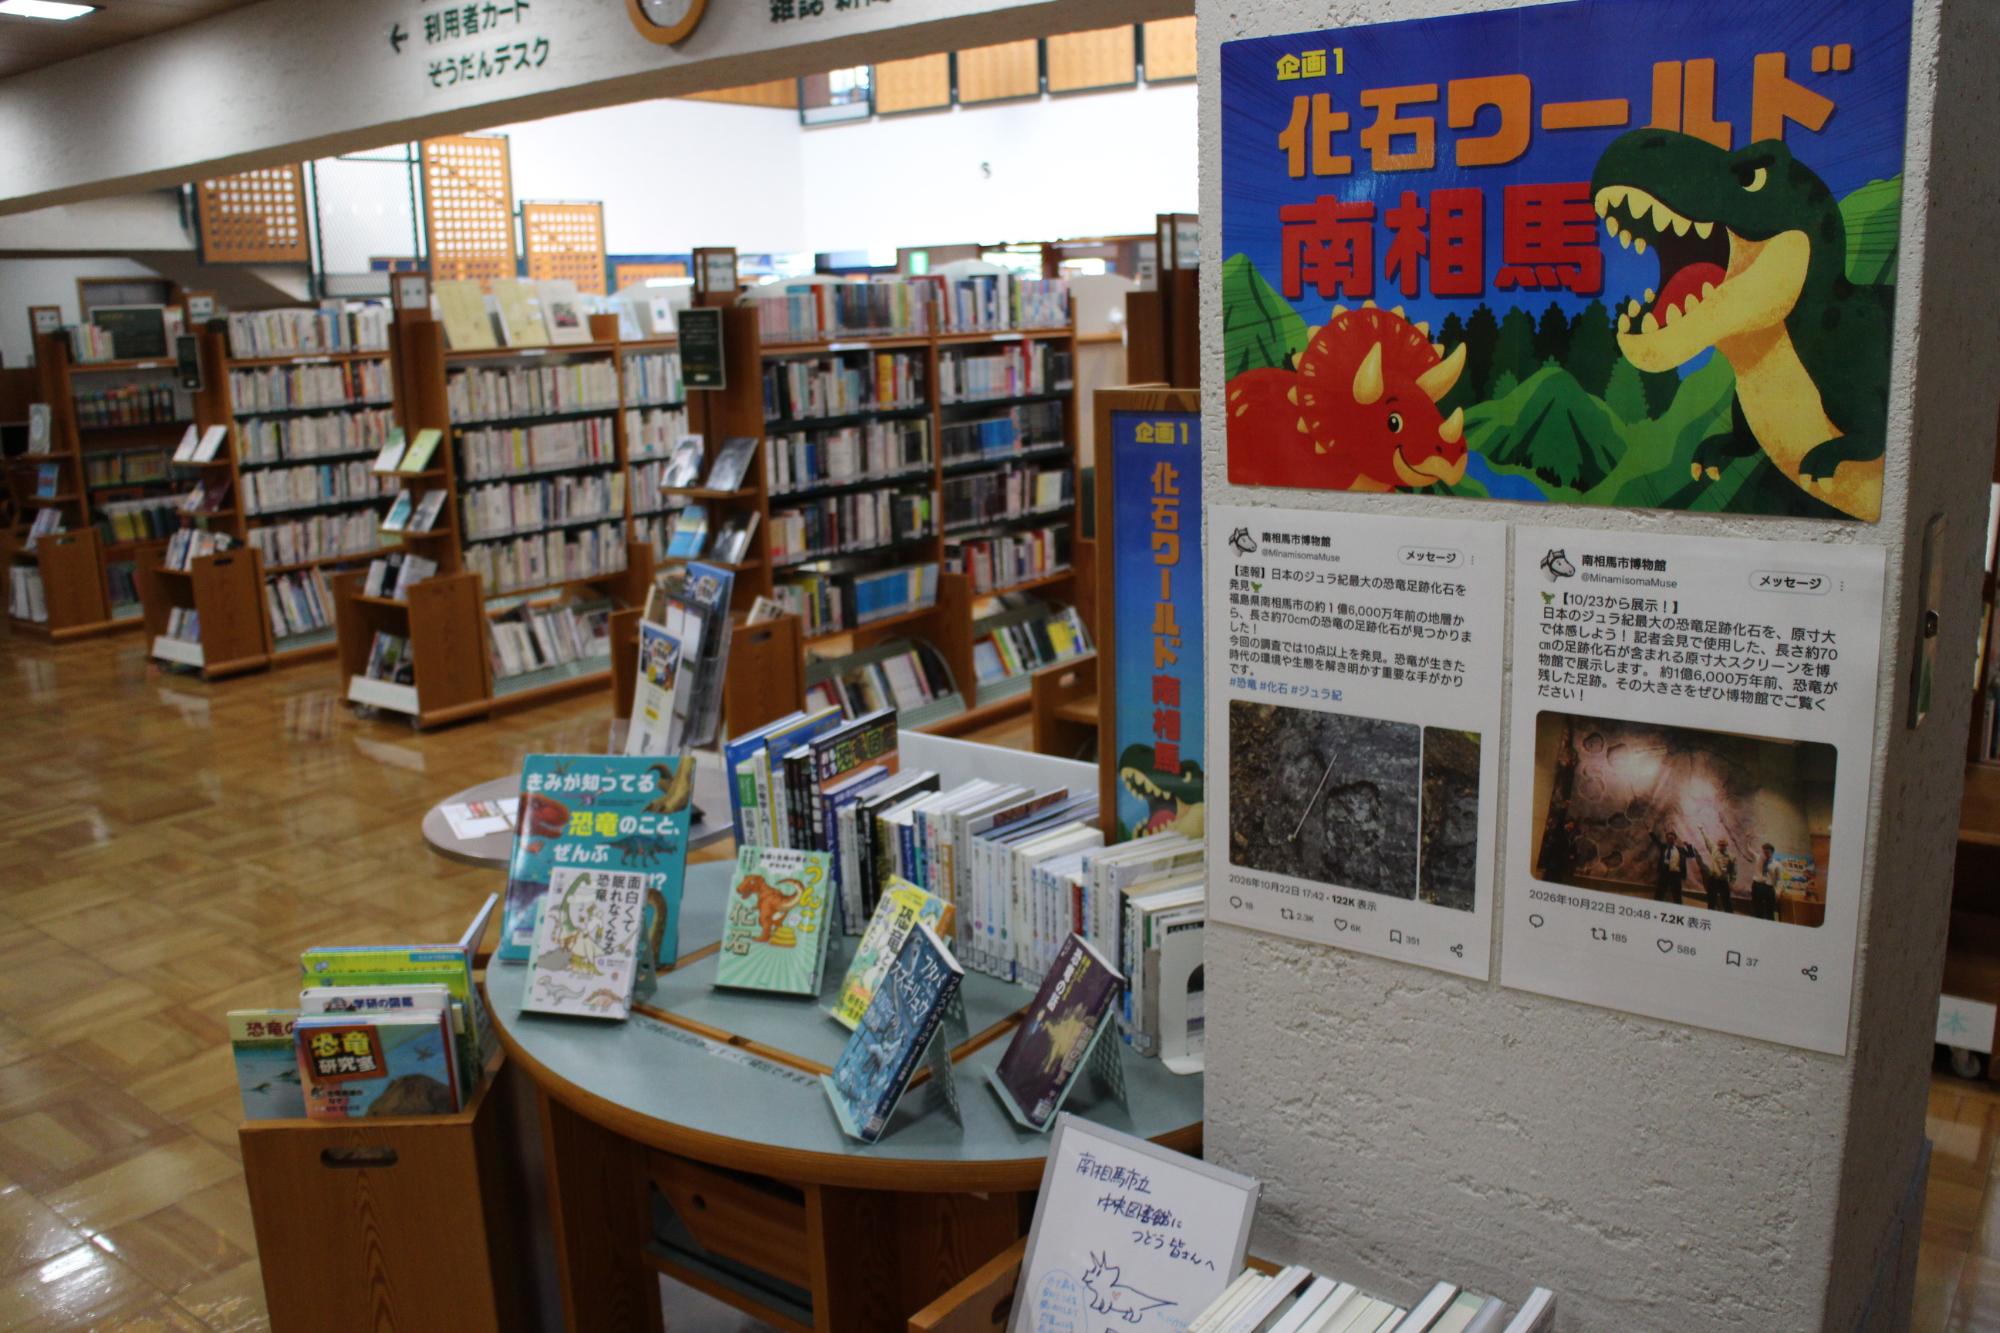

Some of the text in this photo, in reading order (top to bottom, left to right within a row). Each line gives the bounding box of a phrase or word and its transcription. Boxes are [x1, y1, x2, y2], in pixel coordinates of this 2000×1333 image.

[428, 36, 549, 87] そうだんデスク
[1278, 44, 1852, 179] 化石ワールド
[1279, 181, 1606, 298] 南相馬
[1262, 531, 1331, 548] 南相馬市博物館
[1406, 550, 1456, 563] メッセージ
[1582, 553, 1667, 572] 南相馬市博物館
[1229, 578, 1250, 591] 発見
[1581, 572, 1678, 589] @MinamisomaMuse
[1760, 575, 1822, 590] メッセージ
[1230, 663, 1254, 676] です。
[1260, 680, 1288, 695] #化石
[526, 772, 655, 793] きみが知ってる
[569, 811, 680, 837] 恐竜のこと、
[553, 843, 610, 863] ぜんぶ
[624, 875, 641, 932] 面白くて
[797, 856, 823, 933] うんこ
[603, 875, 626, 955] 眠れなくなる
[1687, 916, 1712, 931] 表示
[725, 902, 757, 956] 化石
[318, 1056, 377, 1075] 研究室
[1076, 1152, 1151, 1194] 南相馬市立
